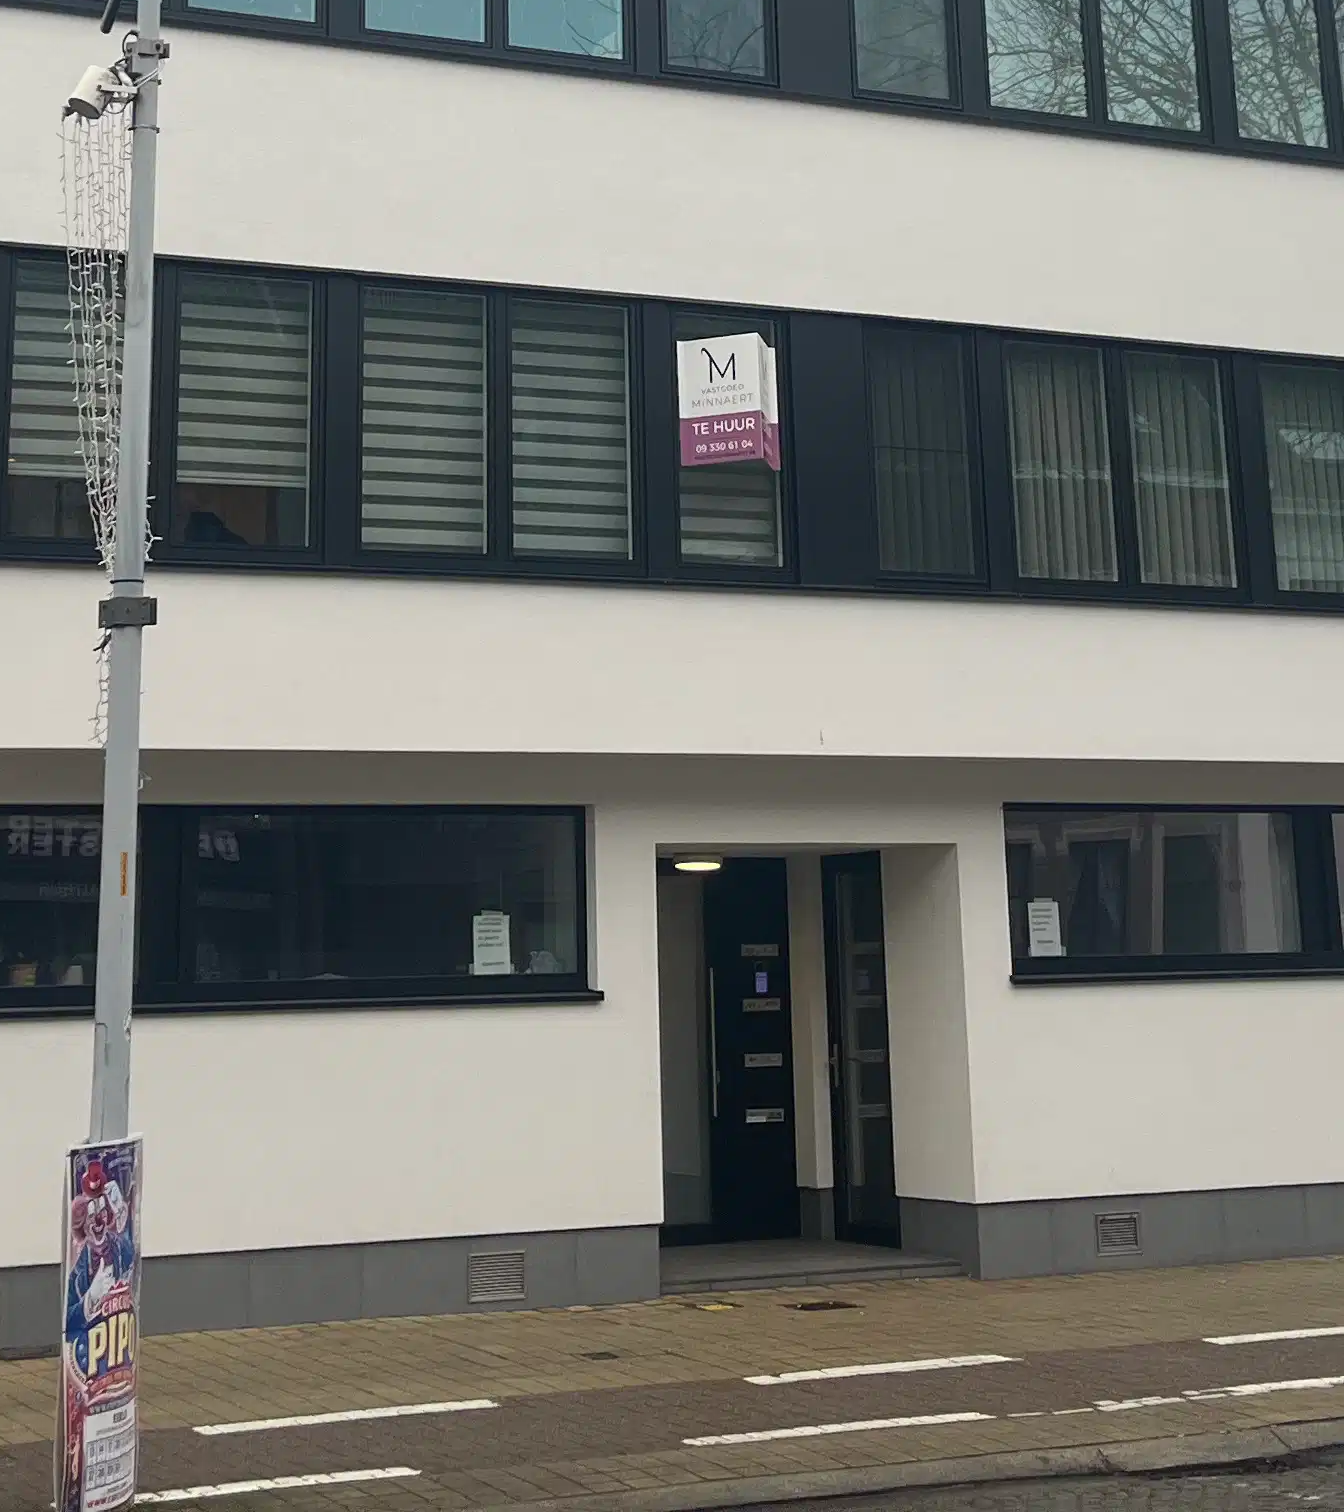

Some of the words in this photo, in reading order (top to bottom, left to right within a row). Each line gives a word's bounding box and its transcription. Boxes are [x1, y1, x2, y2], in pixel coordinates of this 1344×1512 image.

[701, 347, 736, 383] M
[701, 383, 745, 395] VASTGOED
[692, 422, 709, 436] TE
[713, 417, 755, 434] HUUR
[695, 444, 707, 453] 09
[709, 442, 726, 452] 330
[728, 441, 738, 450] 61
[741, 439, 753, 449] 04
[87, 1312, 137, 1378] PIPO
